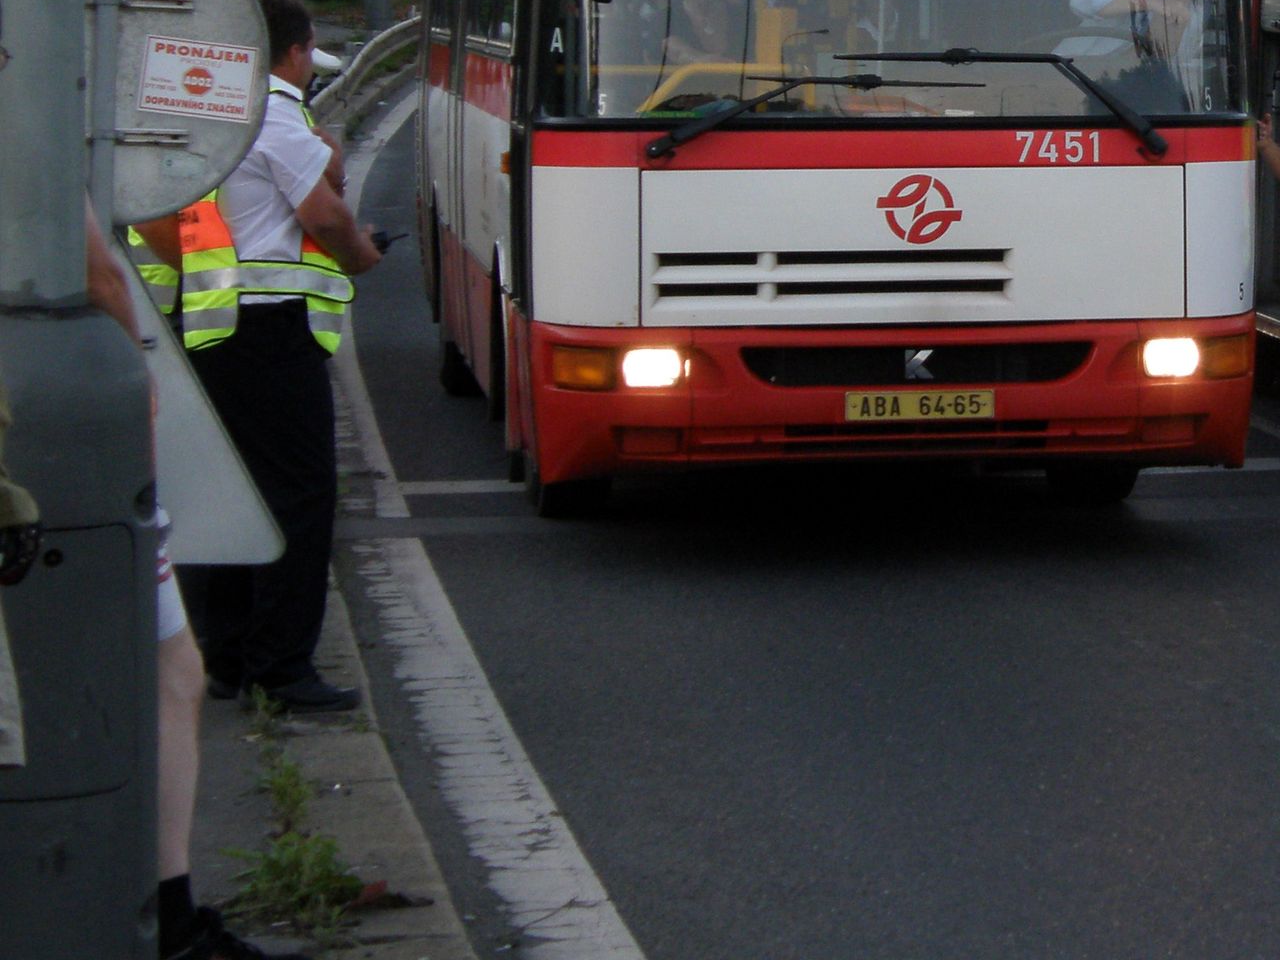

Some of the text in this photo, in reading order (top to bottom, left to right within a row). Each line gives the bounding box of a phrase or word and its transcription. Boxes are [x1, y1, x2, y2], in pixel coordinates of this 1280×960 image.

[550, 27, 563, 53] A
[155, 42, 249, 63] PRONÁJEM
[598, 93, 607, 115] 5
[1204, 87, 1212, 111] 5
[1016, 131, 1100, 163] 7451
[1238, 282, 1244, 301] 5
[905, 349, 934, 379] K
[859, 394, 981, 417] ABA 64-65
